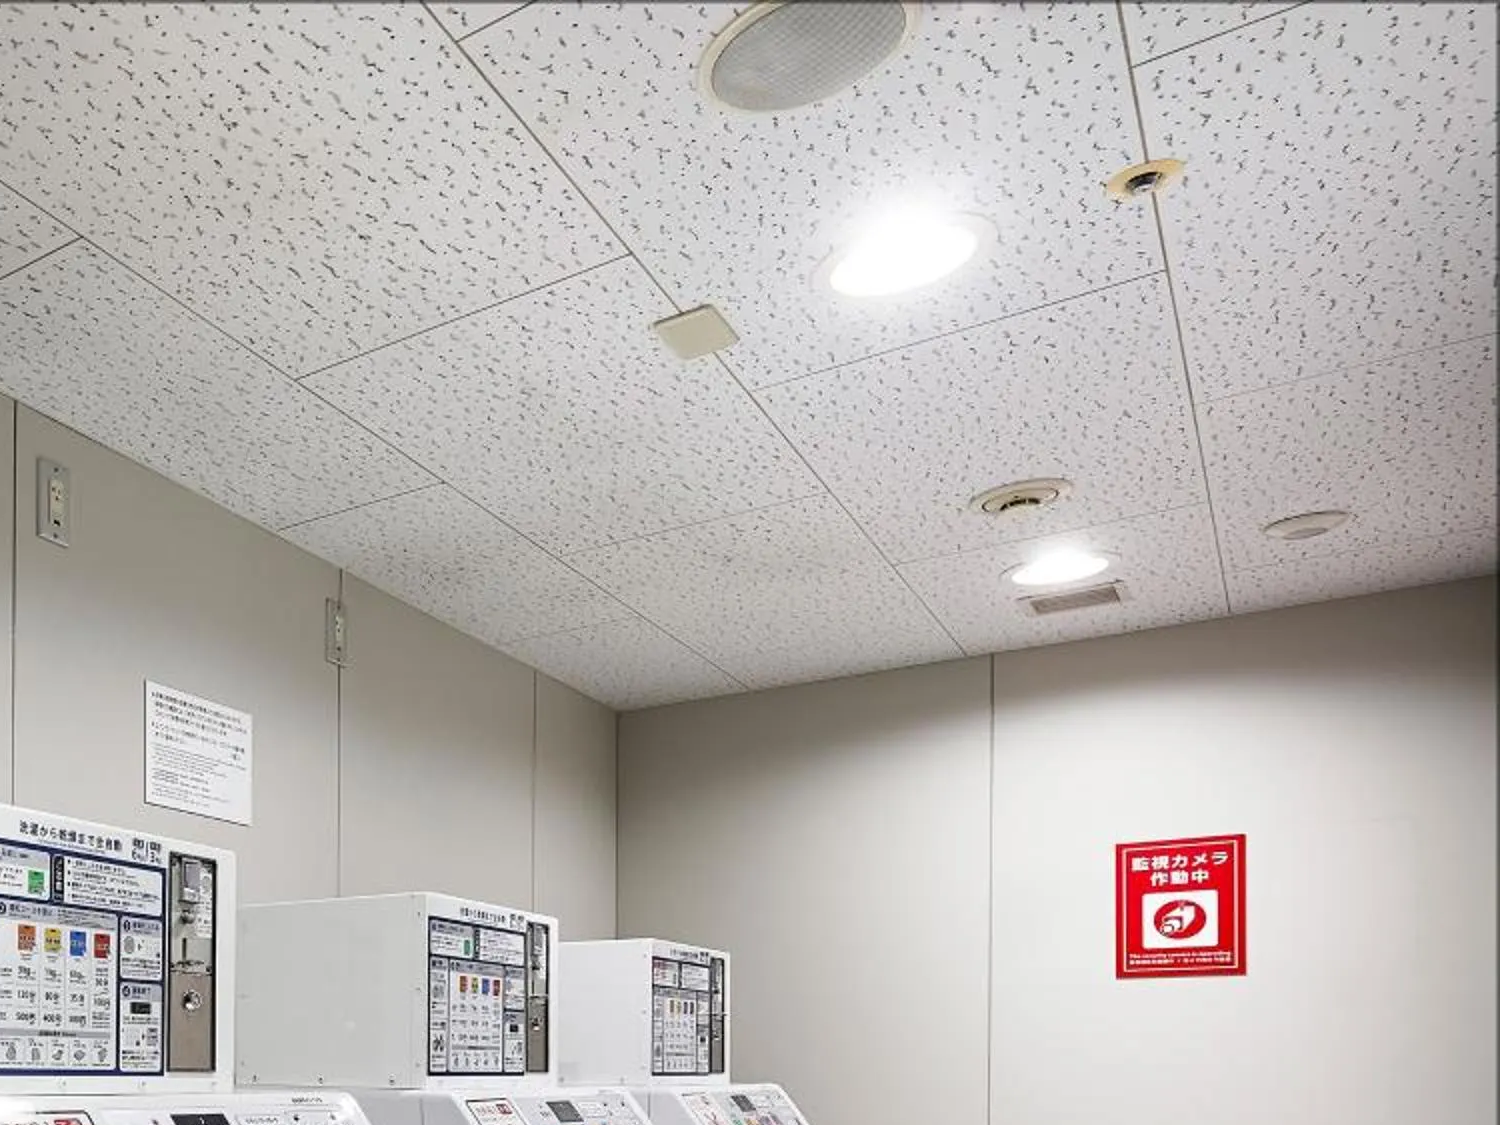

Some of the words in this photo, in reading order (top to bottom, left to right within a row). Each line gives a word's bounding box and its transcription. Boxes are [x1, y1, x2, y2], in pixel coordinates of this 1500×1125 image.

[1131, 851, 1229, 872] 監視カメラ
[1150, 869, 1209, 887] 作動中
